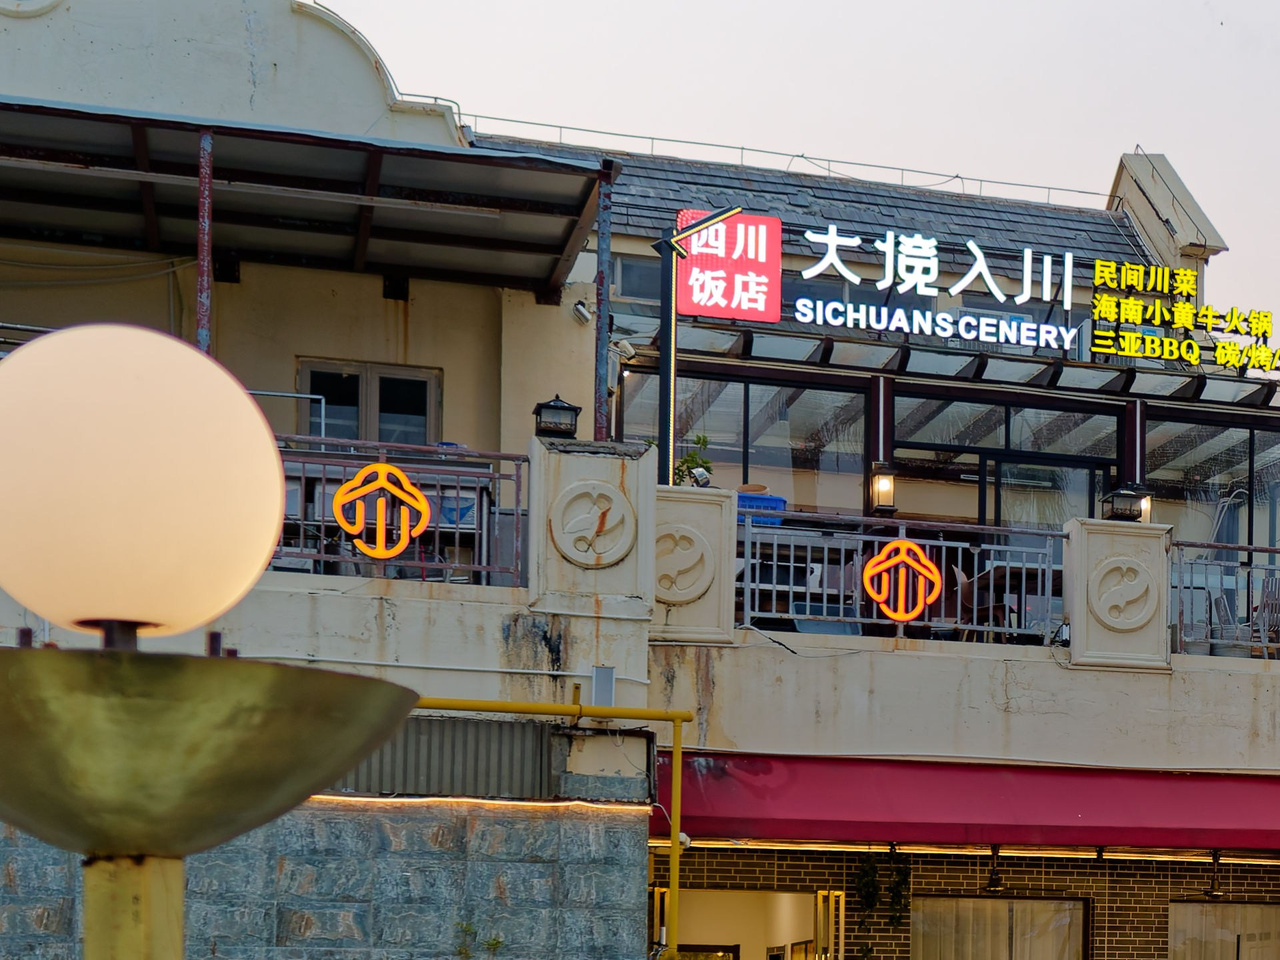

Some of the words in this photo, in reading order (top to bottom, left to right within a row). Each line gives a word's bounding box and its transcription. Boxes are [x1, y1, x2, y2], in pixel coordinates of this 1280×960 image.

[688, 220, 768, 264] 四川
[687, 266, 770, 312] 饭店
[1093, 258, 1199, 297] 民间川菜
[1091, 292, 1274, 339] 海南小黄牛火锅
[1090, 329, 1201, 366] 三亚BBQ
